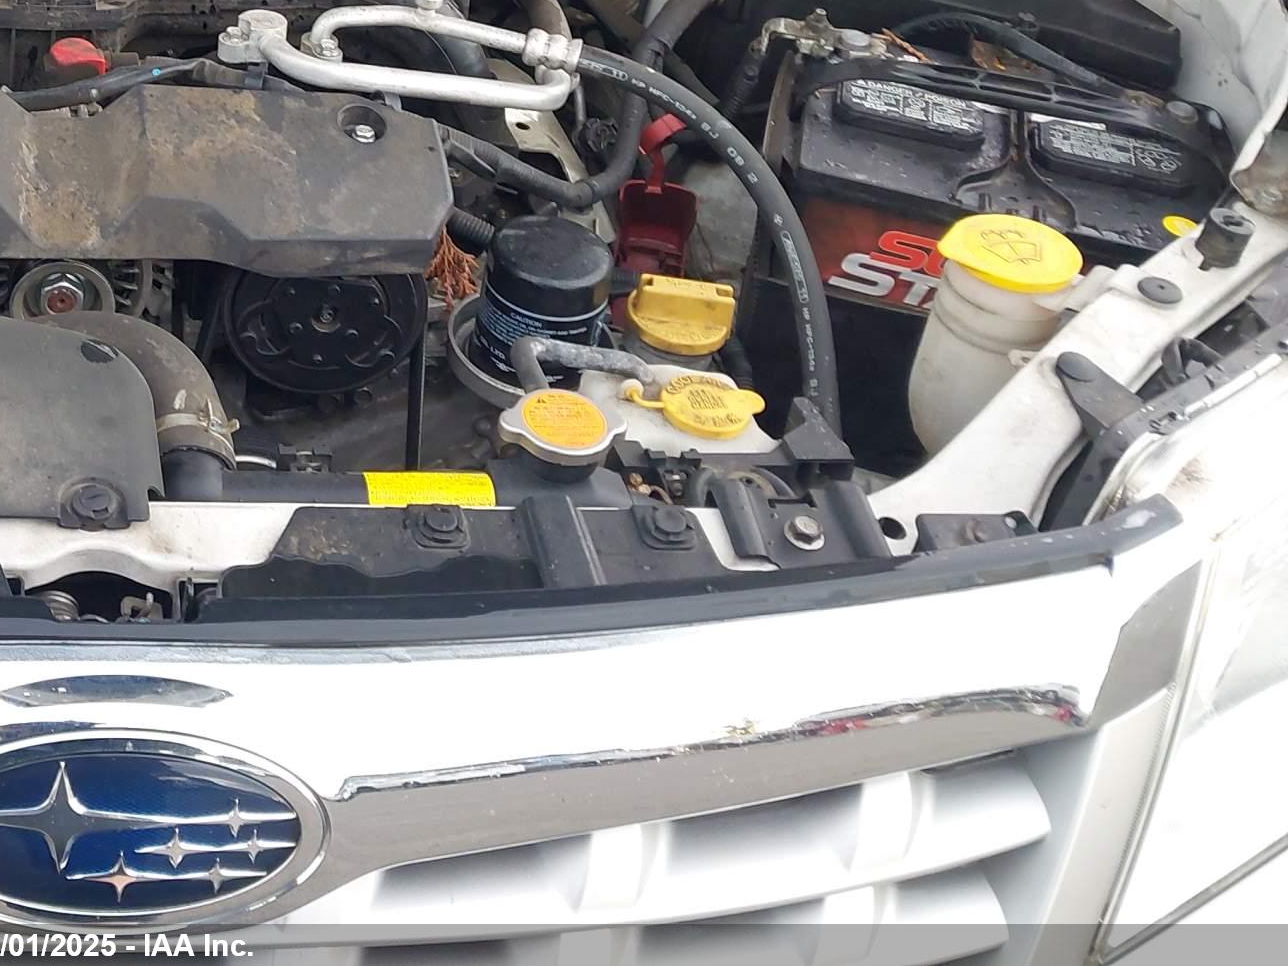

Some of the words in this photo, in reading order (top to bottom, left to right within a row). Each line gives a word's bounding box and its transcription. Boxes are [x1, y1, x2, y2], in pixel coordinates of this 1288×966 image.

[865, 80, 912, 97] DANGER
[924, 93, 966, 107] POISON
[510, 312, 543, 328] CAUTION
